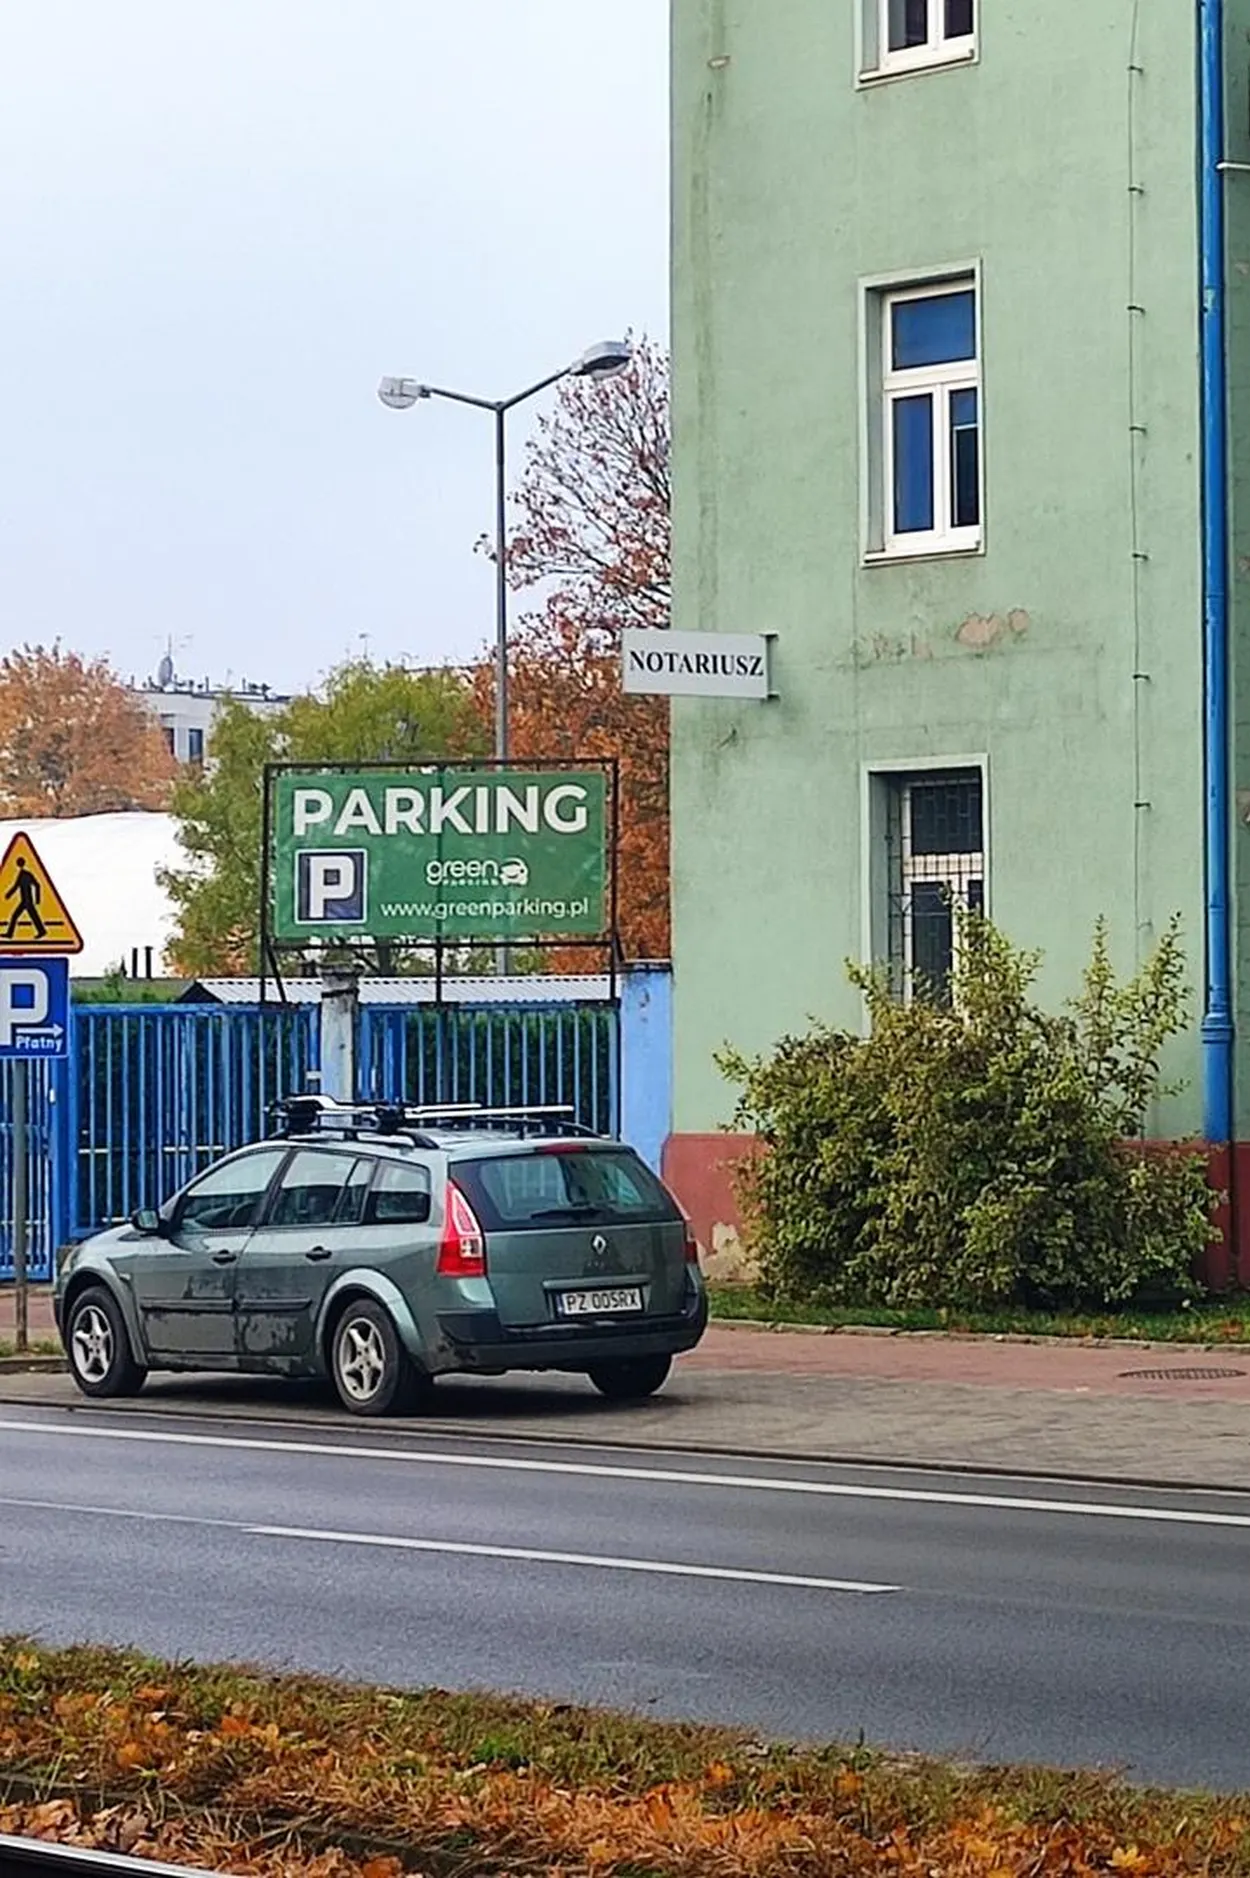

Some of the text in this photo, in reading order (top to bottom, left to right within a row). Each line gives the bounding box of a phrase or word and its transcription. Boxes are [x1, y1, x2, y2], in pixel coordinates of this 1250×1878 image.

[629, 650, 764, 677] NOTARIUSZ
[293, 785, 588, 836] PARKING
[308, 855, 355, 918] P
[425, 860, 499, 886] green
[380, 898, 589, 920] www.greenparking.pl
[0, 968, 48, 1046] P
[566, 1294, 587, 1311] PZ
